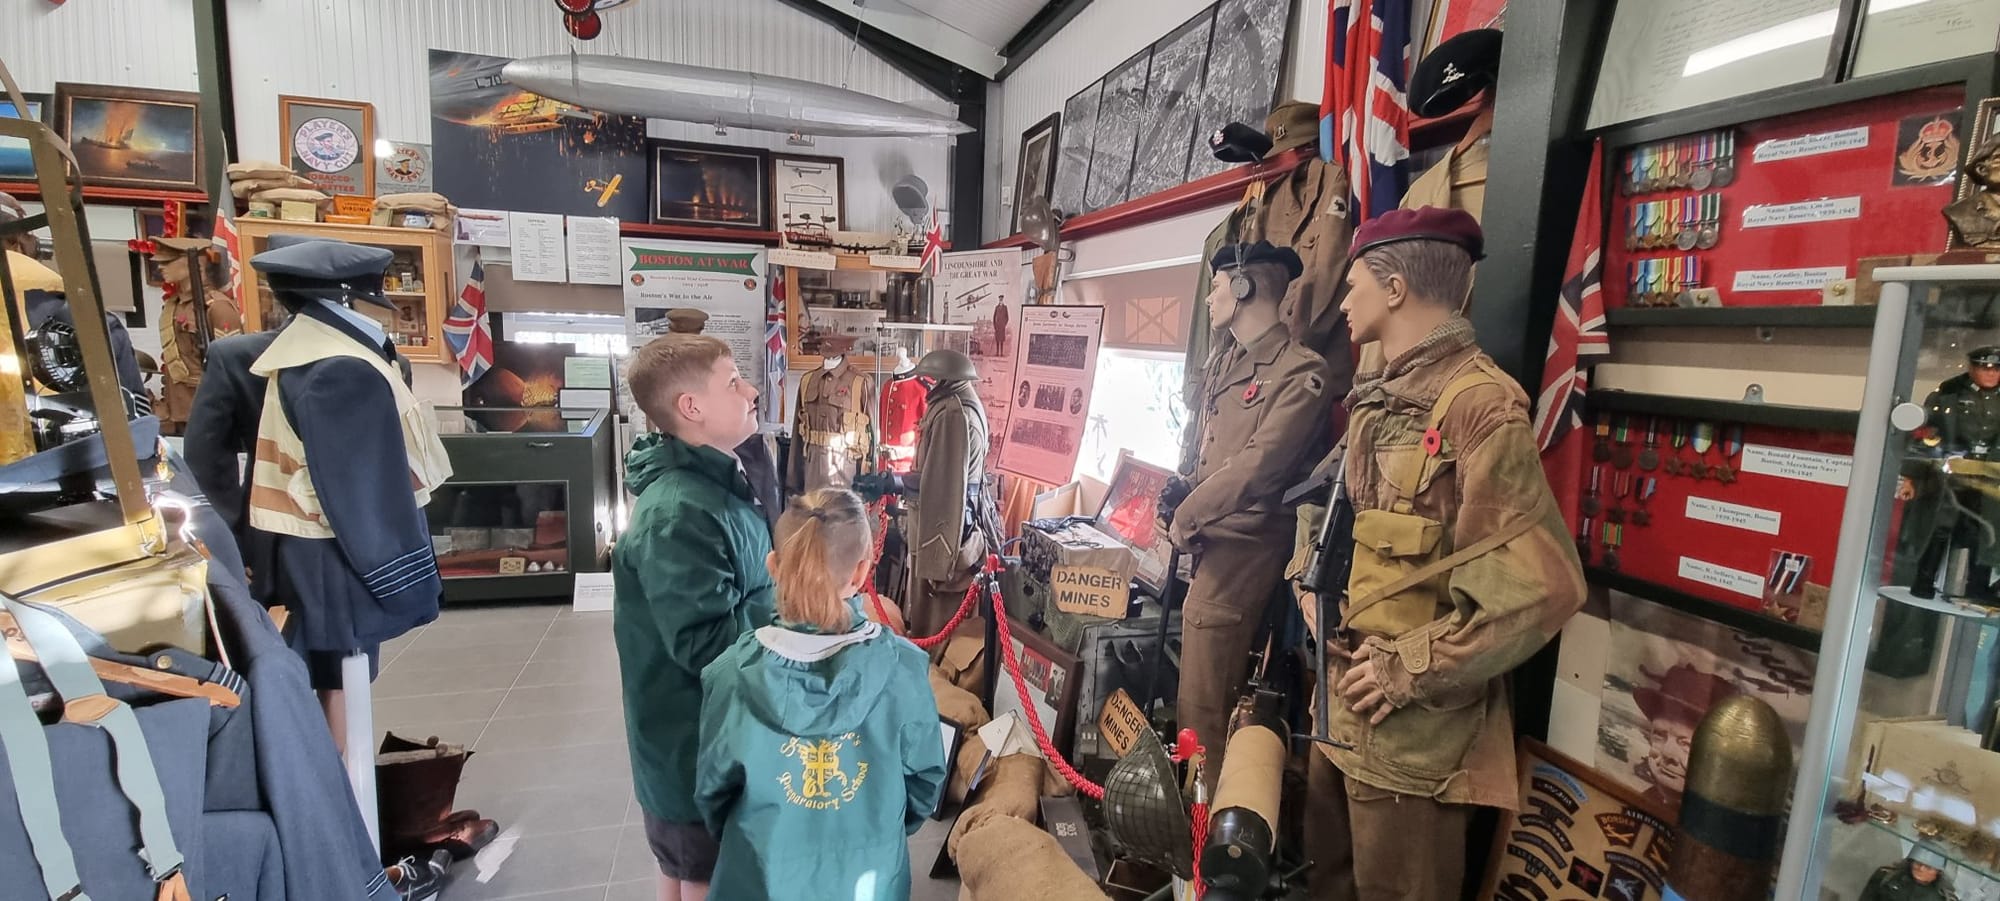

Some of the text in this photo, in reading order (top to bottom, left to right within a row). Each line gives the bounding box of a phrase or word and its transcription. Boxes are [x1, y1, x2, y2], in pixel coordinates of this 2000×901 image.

[301, 150, 353, 170] NAVY CUT
[640, 254, 749, 270] BOSTON AT WAR
[944, 260, 987, 270] LINCOLNSHIRE
[960, 270, 981, 279] GREAT
[983, 270, 998, 278] WAR
[640, 292, 667, 300] Boston's
[1056, 570, 1122, 590] DANGER
[1059, 590, 1111, 608] MINES
[1110, 695, 1143, 737] DANGER
[1103, 713, 1130, 751] MINES
[776, 771, 840, 810] Preparatory
[841, 761, 869, 802] School
